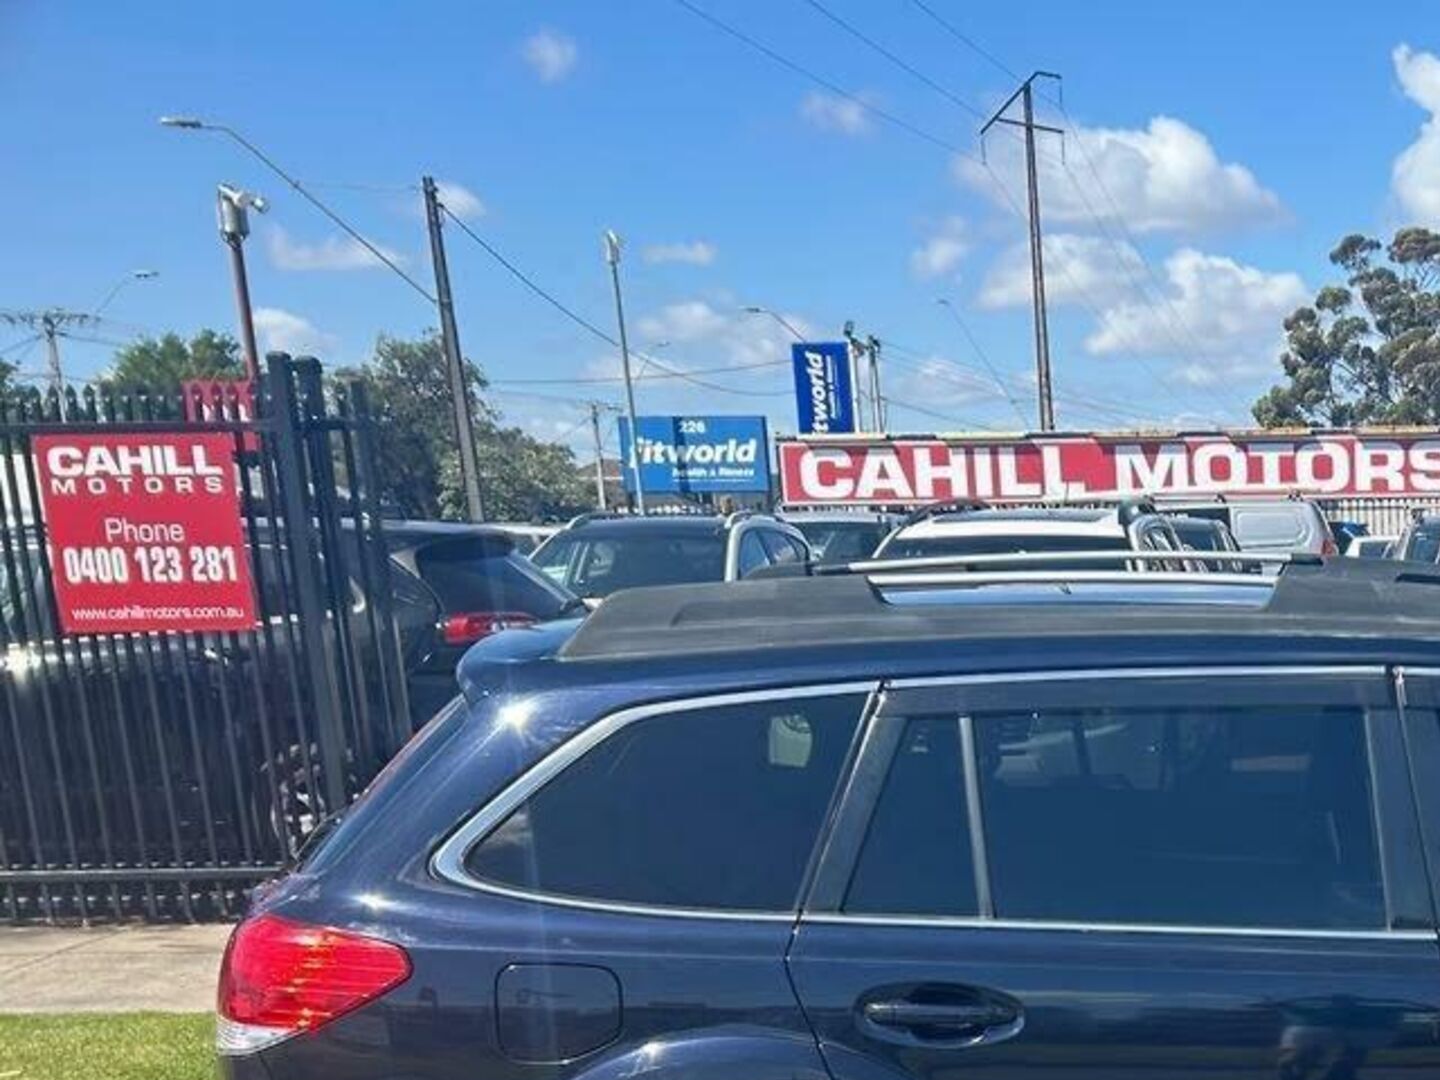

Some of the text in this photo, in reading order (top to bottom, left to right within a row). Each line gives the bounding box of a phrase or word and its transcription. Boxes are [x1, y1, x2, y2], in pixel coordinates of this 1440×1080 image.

[47, 446, 223, 475] CAHILL
[799, 446, 1086, 499] CAHILL
[52, 477, 224, 495] MOTORS
[105, 519, 184, 542] Phone
[63, 547, 237, 584] 0400 123 281
[72, 605, 244, 620] www.cahillmotors.com.au
